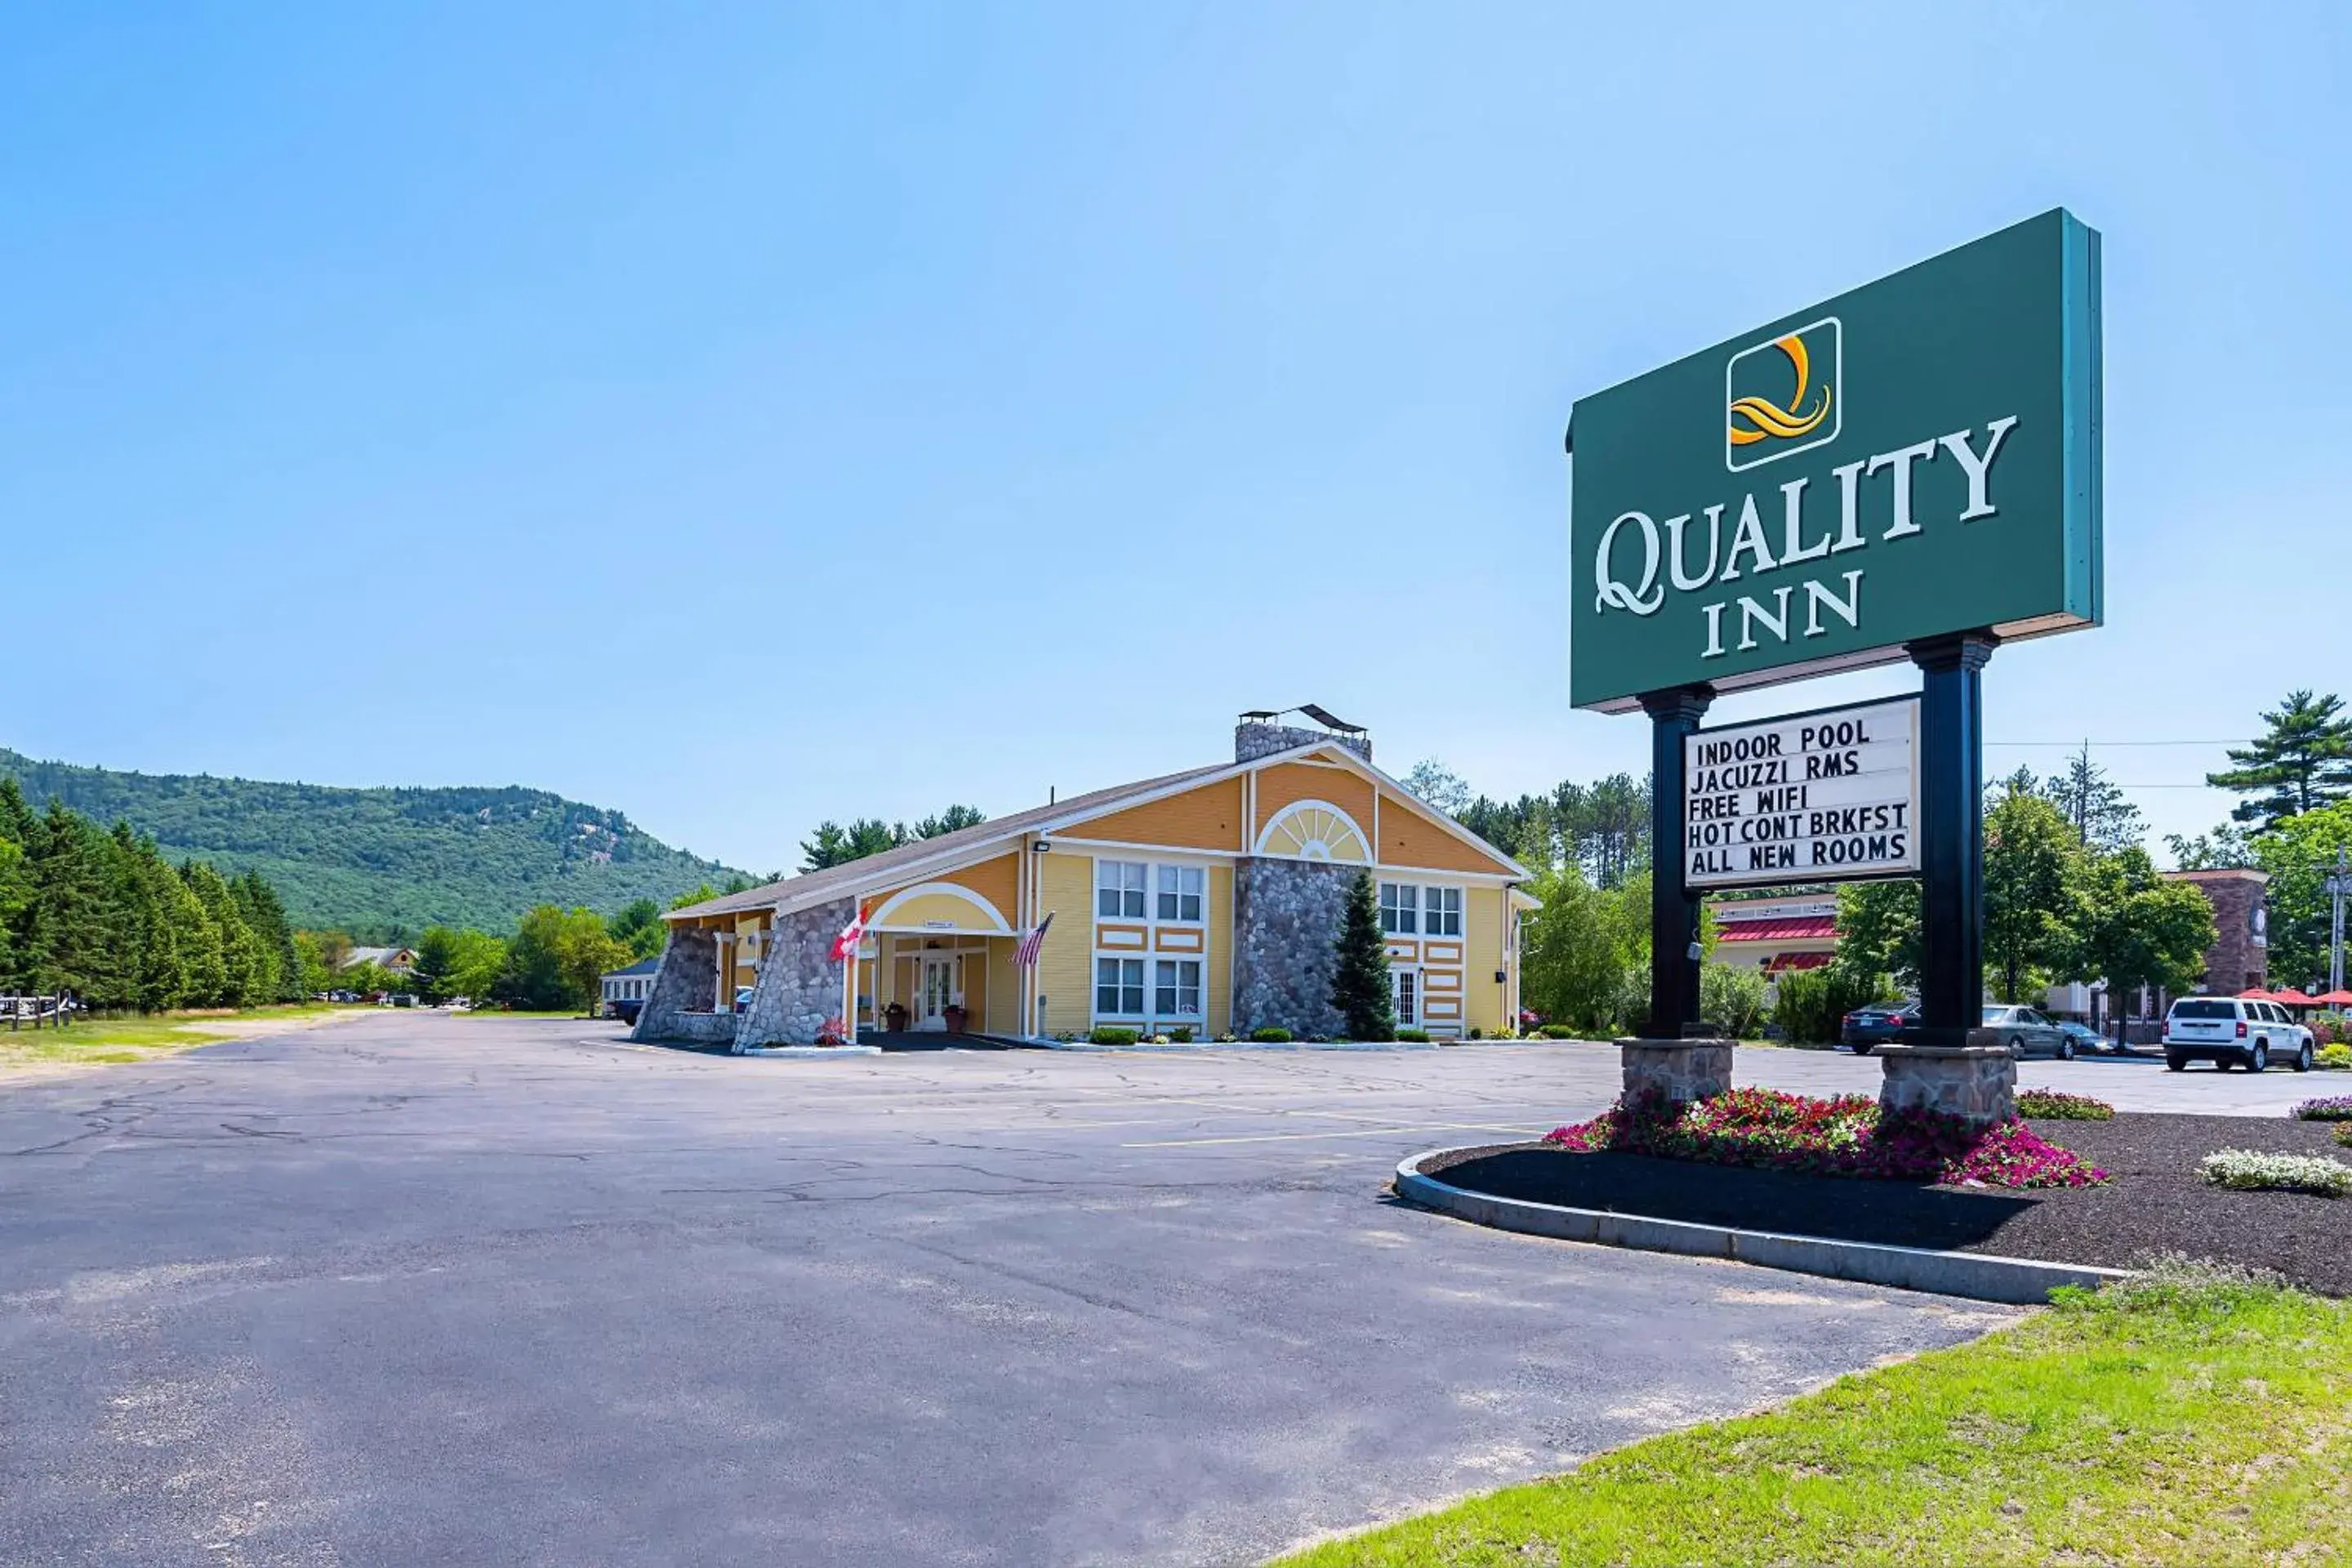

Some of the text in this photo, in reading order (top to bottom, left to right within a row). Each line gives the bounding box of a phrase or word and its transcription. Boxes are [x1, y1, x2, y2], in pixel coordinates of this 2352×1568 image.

[1595, 414, 2018, 615] QUALITY
[1700, 569, 1864, 658] INN
[1697, 719, 1870, 766] INDOOR POOL
[1690, 750, 1860, 795] JACUZZI RMS
[1688, 803, 1908, 849] HOT CONT BRKFST
[1689, 785, 1808, 822] FREE WIFI
[1691, 833, 1907, 875] ALL NEW ROOMS
